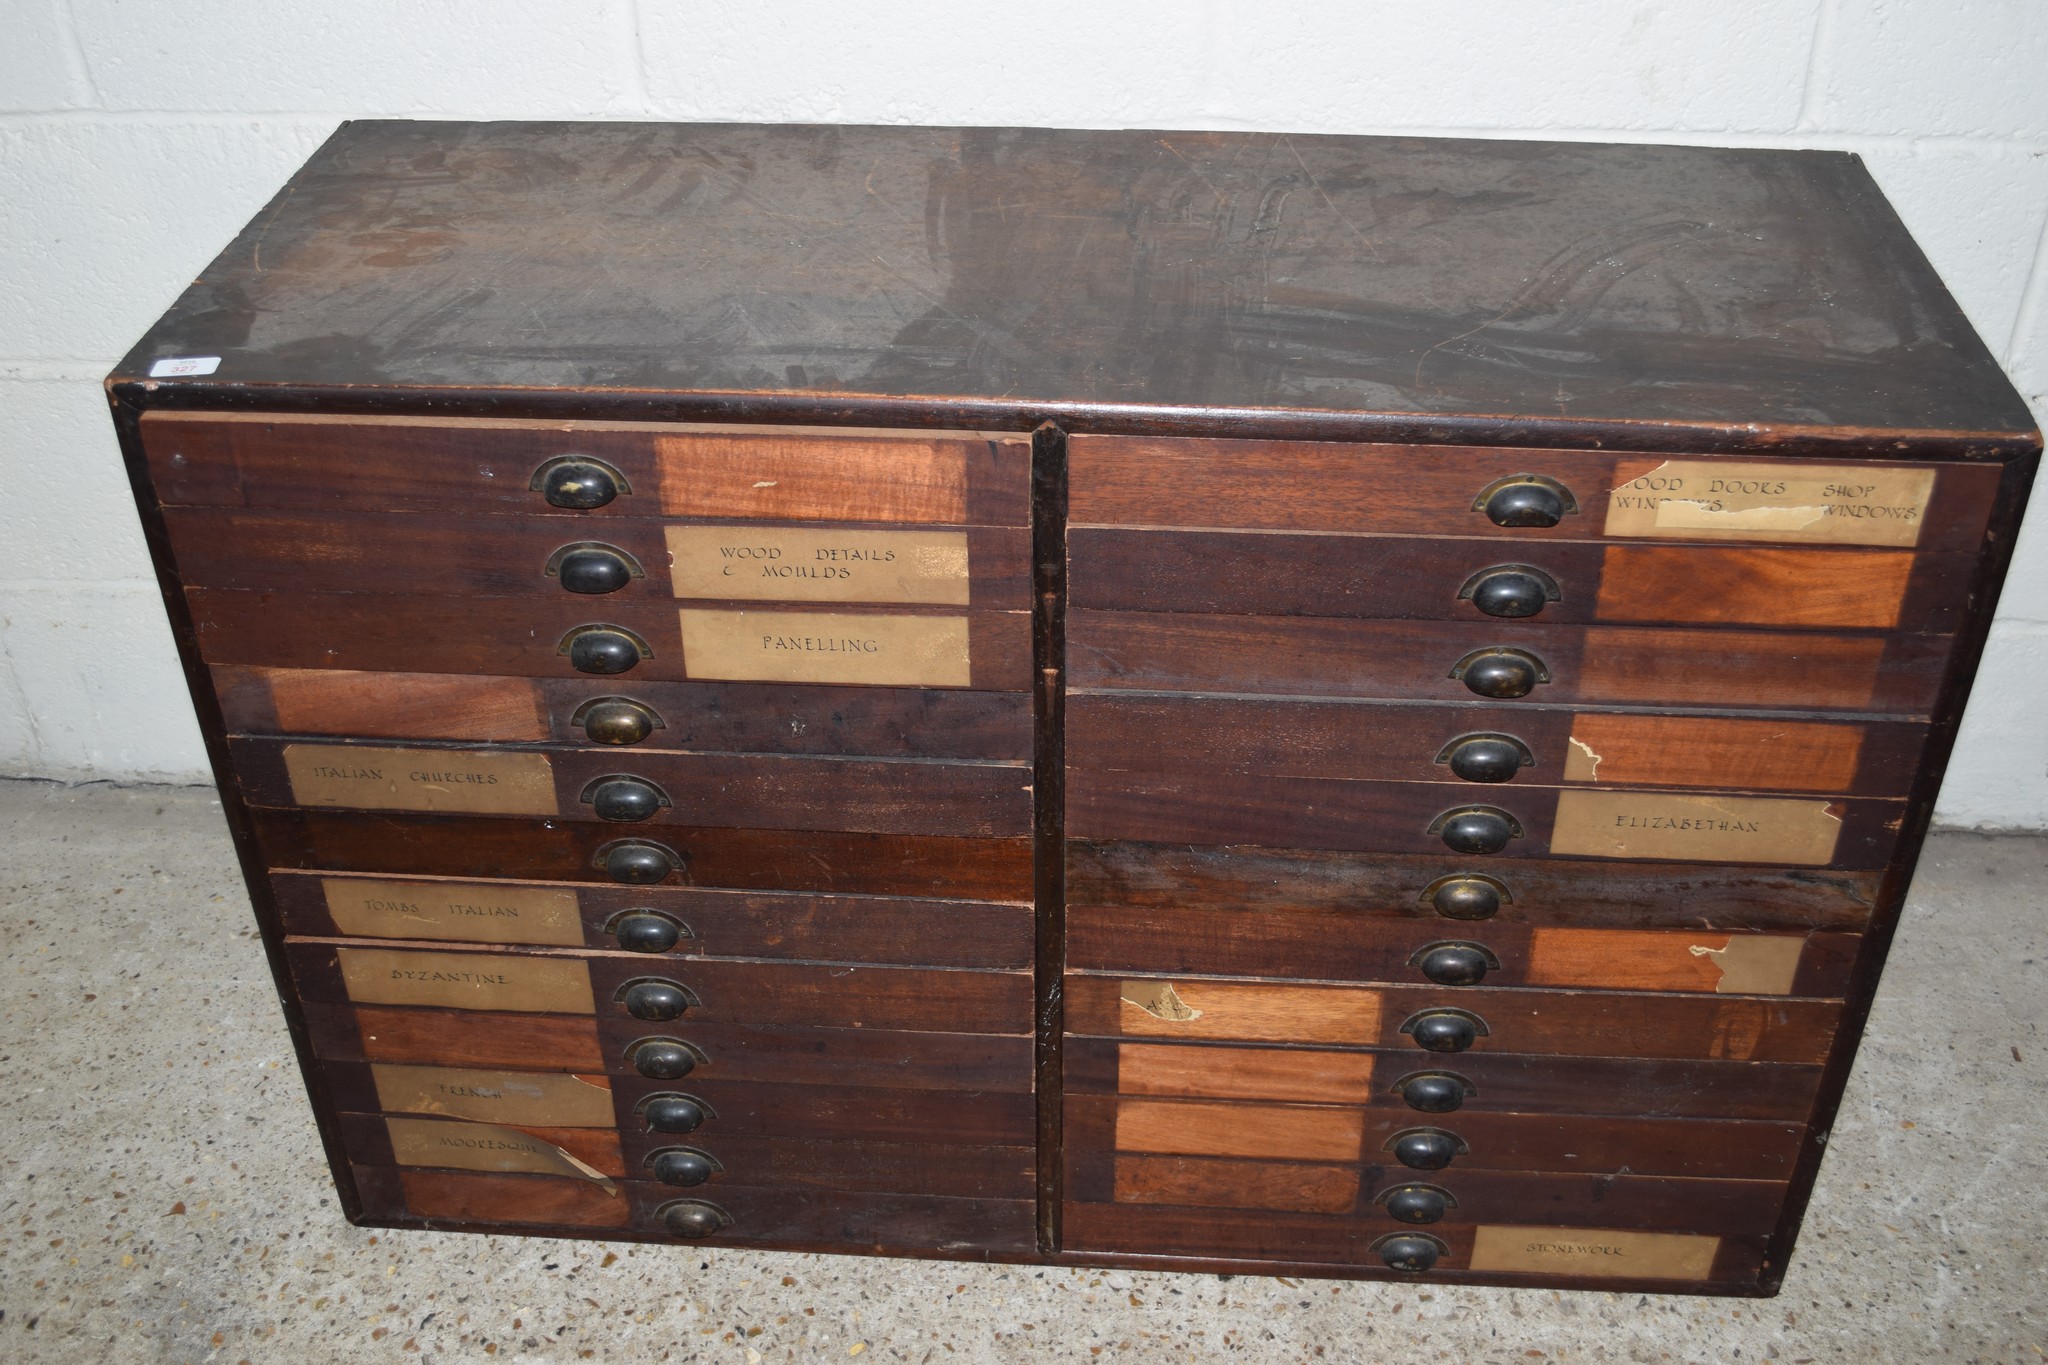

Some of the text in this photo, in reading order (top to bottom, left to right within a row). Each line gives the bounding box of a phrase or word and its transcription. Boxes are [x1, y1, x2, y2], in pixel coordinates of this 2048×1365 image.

[1624, 477, 1876, 498] OOD DOORS SHOP
[720, 547, 896, 562] WOOD DETAILS
[761, 565, 851, 579] MOULDS
[762, 635, 878, 652] PANELLING
[314, 767, 498, 785] ITALIAN CHURCHES
[1615, 815, 1760, 833] ELIZABETHAN
[364, 900, 519, 917] TOMBS ITALIAN
[391, 969, 512, 984] BYZANTINE
[439, 1084, 503, 1099] FRENCH
[1526, 1243, 1624, 1257] STONEWORK
